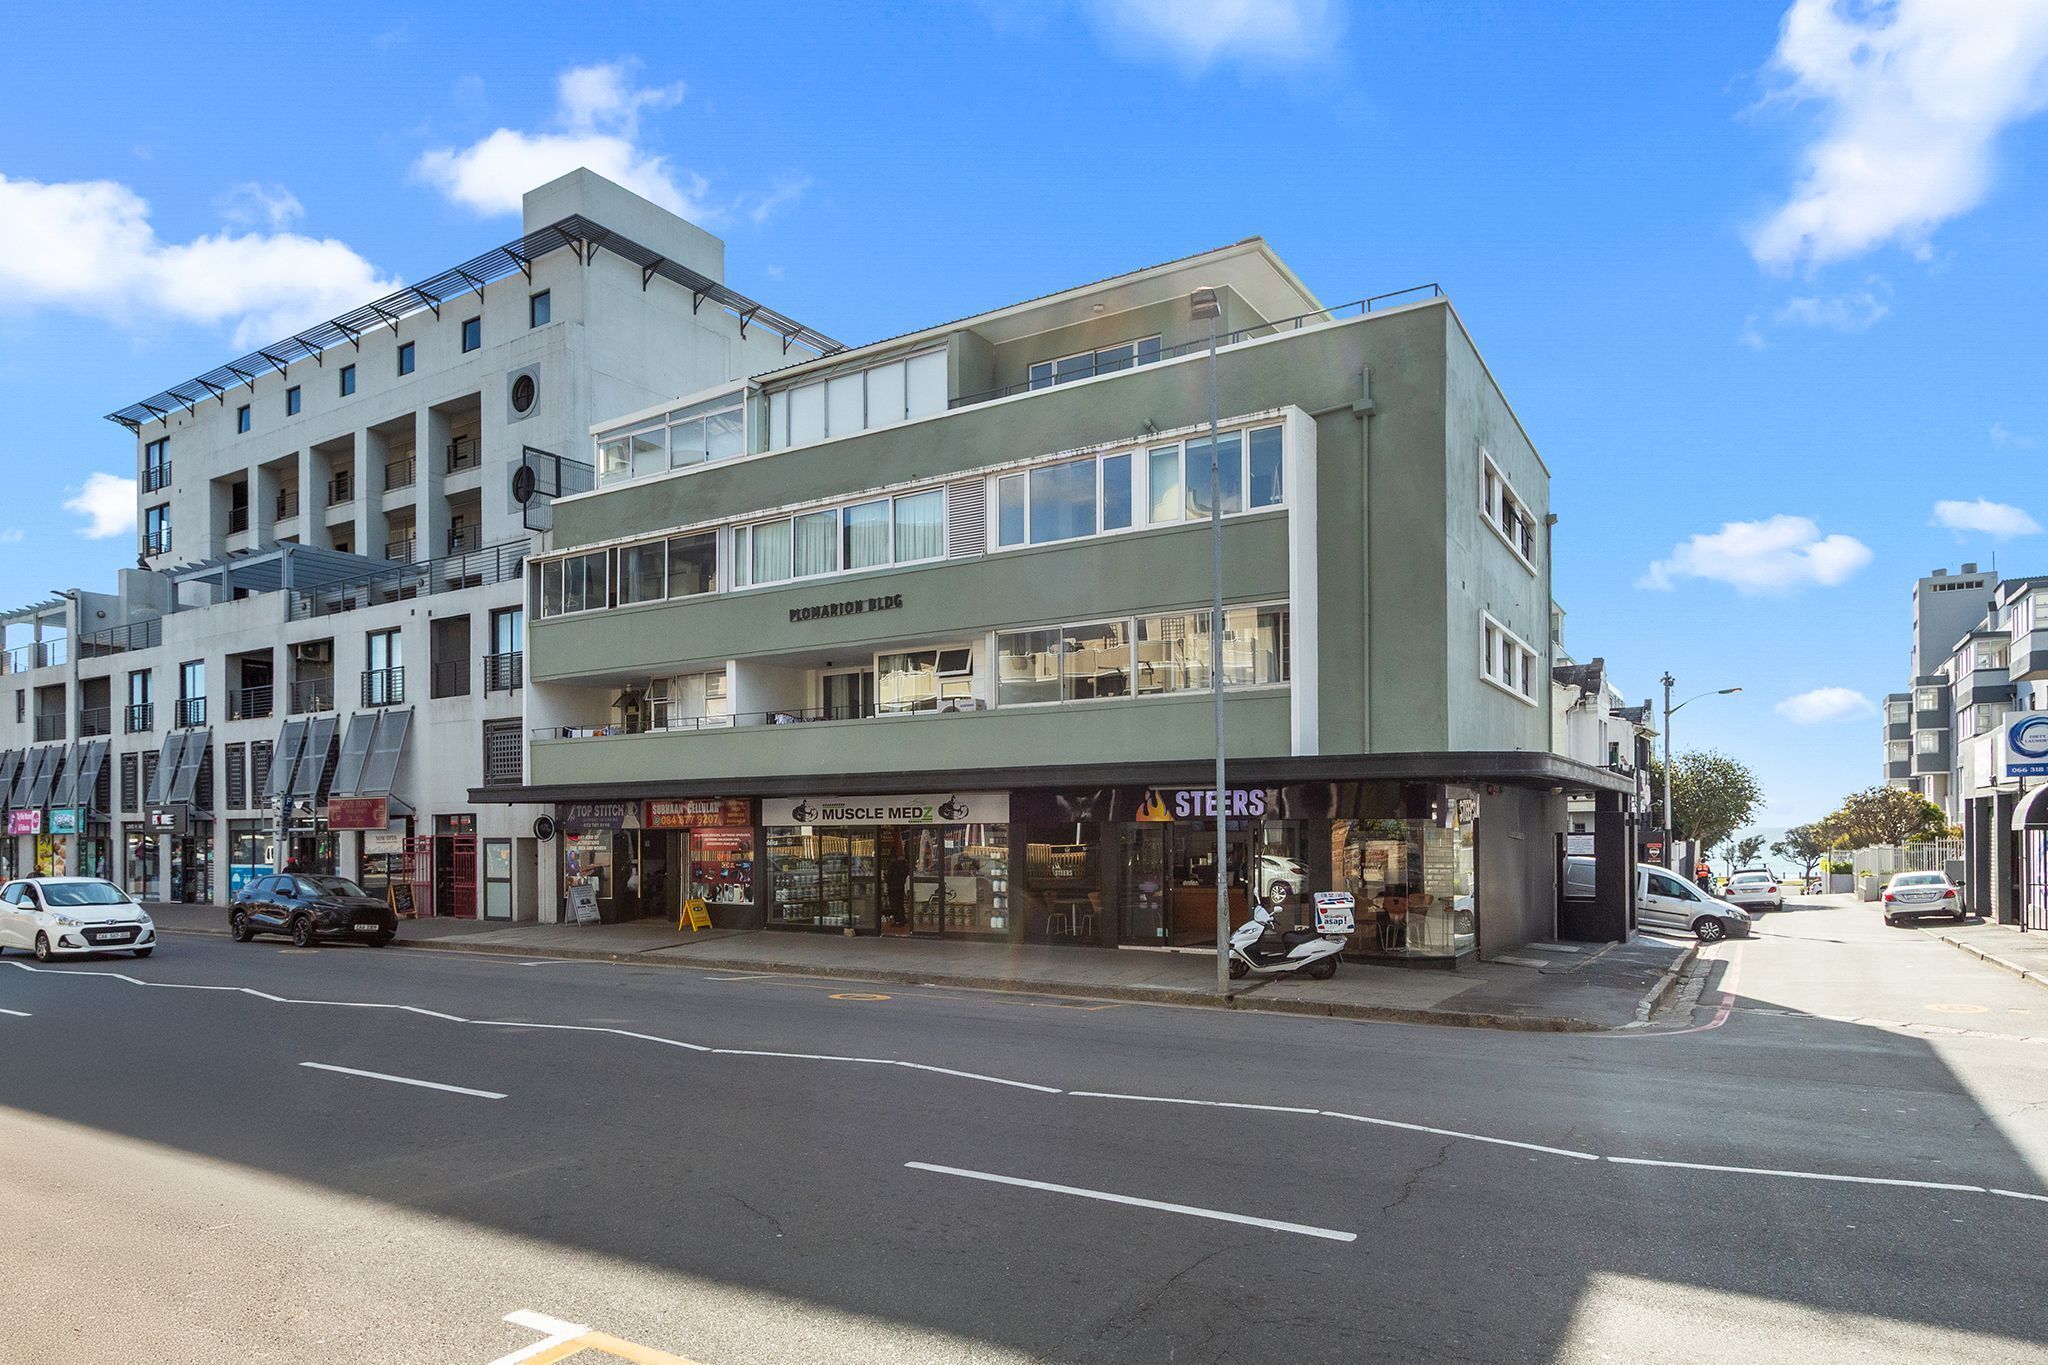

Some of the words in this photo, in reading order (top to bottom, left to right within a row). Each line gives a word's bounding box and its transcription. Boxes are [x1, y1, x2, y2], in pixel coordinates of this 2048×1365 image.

[789, 600, 863, 622] PLOMARION
[868, 594, 903, 611] BLDG
[1175, 789, 1265, 817] STEERS
[576, 805, 592, 817] TOP
[594, 804, 624, 817] STITCH
[822, 808, 884, 820] MUSCLE
[888, 806, 933, 819] MEDZ
[661, 815, 676, 825] 084
[679, 814, 694, 825] 877
[697, 813, 719, 825] 9207
[1324, 916, 1347, 926] asap!
